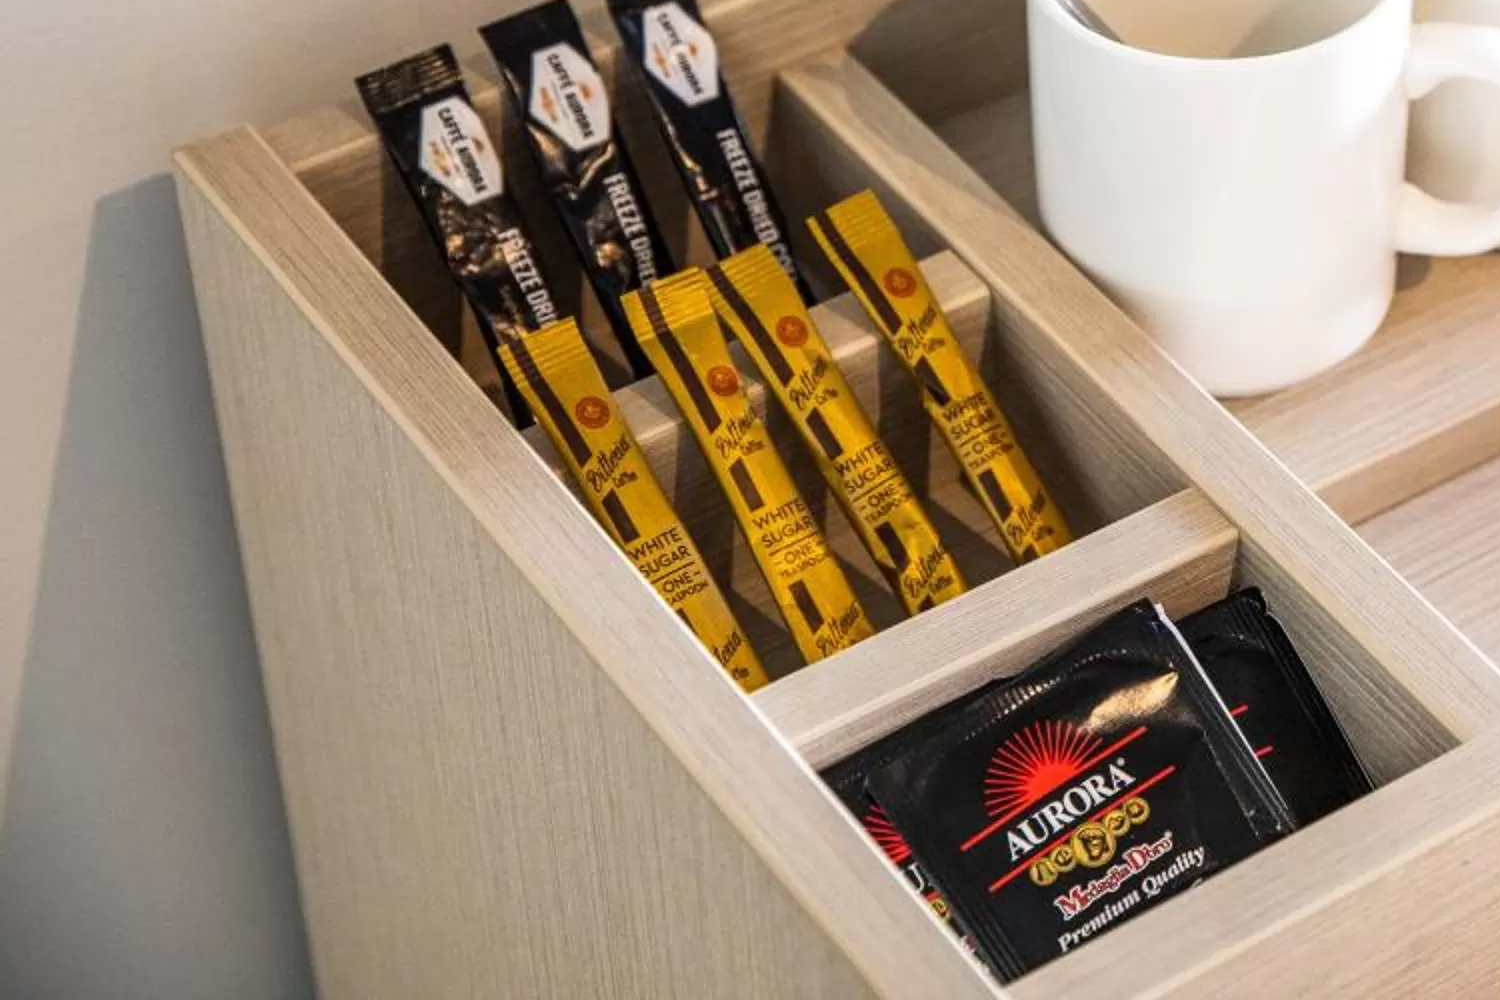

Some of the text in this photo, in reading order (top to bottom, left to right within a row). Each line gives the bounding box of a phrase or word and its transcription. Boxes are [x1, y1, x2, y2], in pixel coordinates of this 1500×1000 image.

[716, 128, 780, 244] FREEZE DRIED
[603, 172, 646, 239] FREEZE
[497, 228, 544, 293] FREEZE
[834, 440, 883, 476] WHITE
[845, 459, 894, 493] SUGAR
[751, 498, 807, 530] WHITE
[628, 527, 682, 560] WHITE
[760, 515, 814, 548] SUGAR
[638, 545, 691, 577] SUGAR
[784, 541, 815, 564] ONE
[662, 571, 692, 593] ONE
[1006, 762, 1137, 862] AURORA
[1057, 846, 1206, 953] Premium Quality
